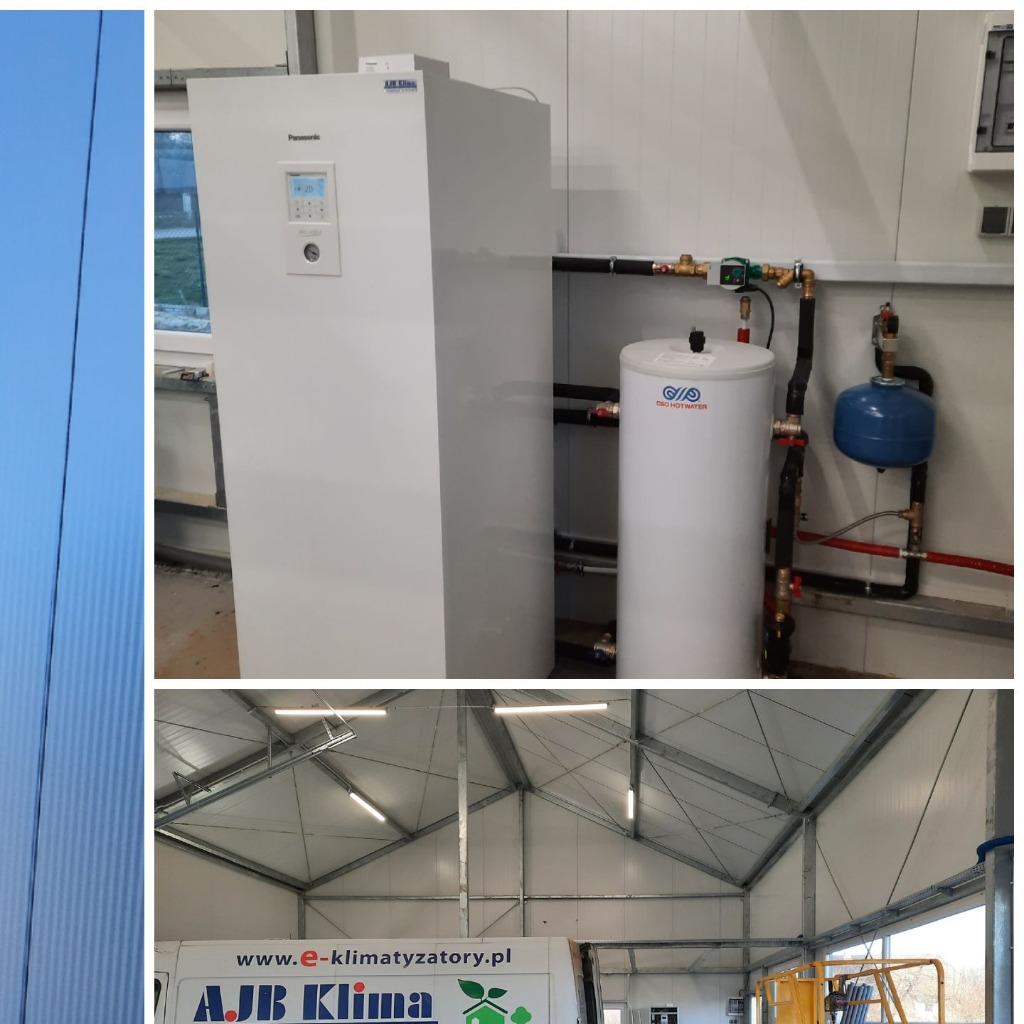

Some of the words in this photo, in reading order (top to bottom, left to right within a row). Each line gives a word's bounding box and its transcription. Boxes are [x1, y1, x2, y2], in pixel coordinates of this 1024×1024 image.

[288, 133, 321, 141] Panasonic
[670, 402, 708, 410] HOTWATER
[236, 948, 512, 968] www.e-klimatyzatory.pl
[193, 984, 287, 1023] AJB
[302, 981, 433, 1021] Klima
